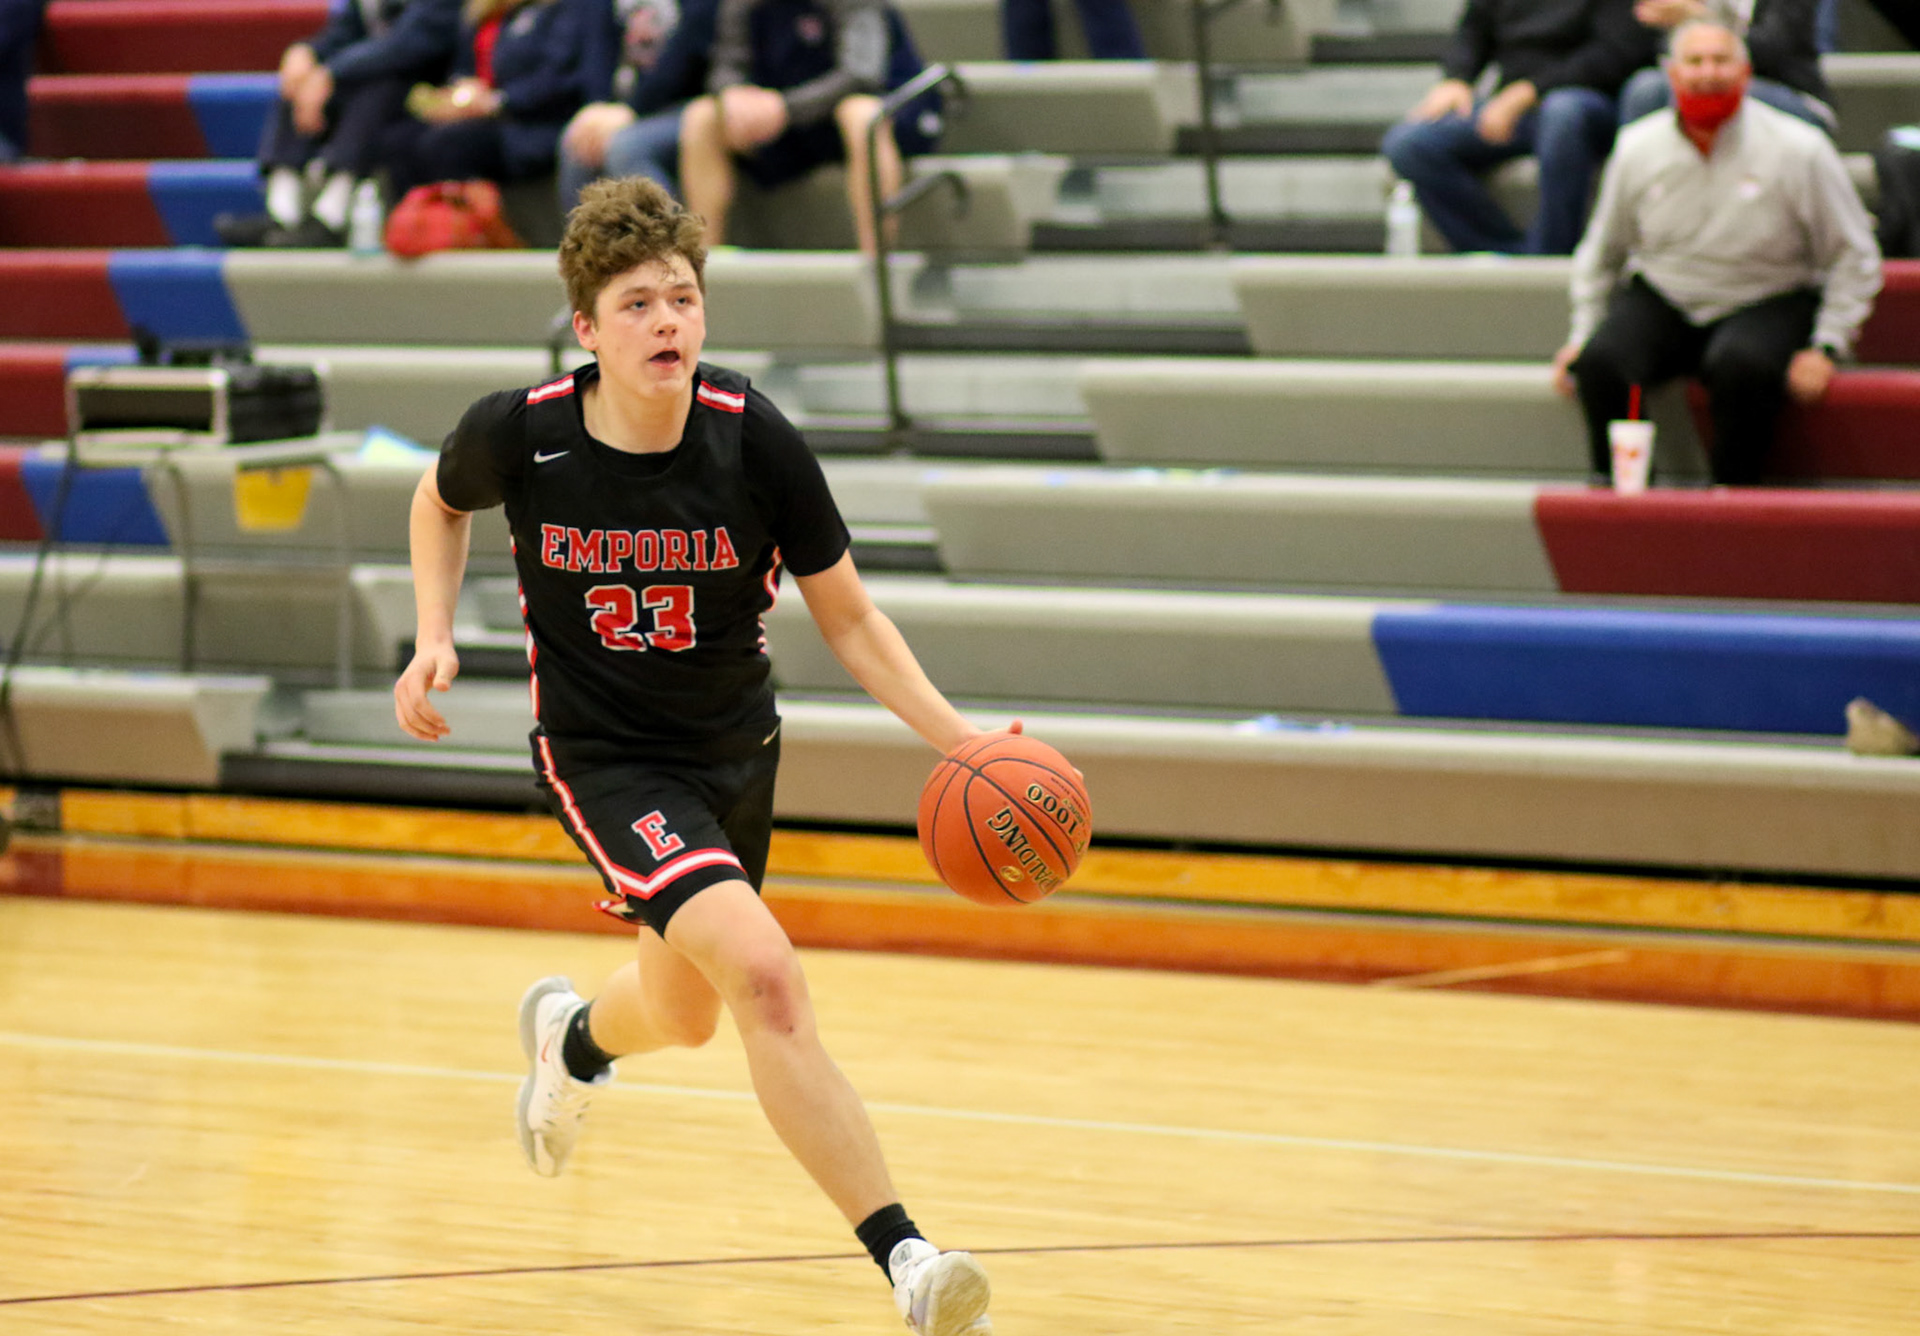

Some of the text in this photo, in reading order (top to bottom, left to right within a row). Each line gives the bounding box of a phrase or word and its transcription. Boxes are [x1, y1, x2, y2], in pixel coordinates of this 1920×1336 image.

[541, 523, 739, 573] EMPORIA
[584, 584, 697, 652] 23
[631, 810, 686, 861] E
[1025, 783, 1078, 836] 1000
[986, 806, 1061, 895] PALDING
